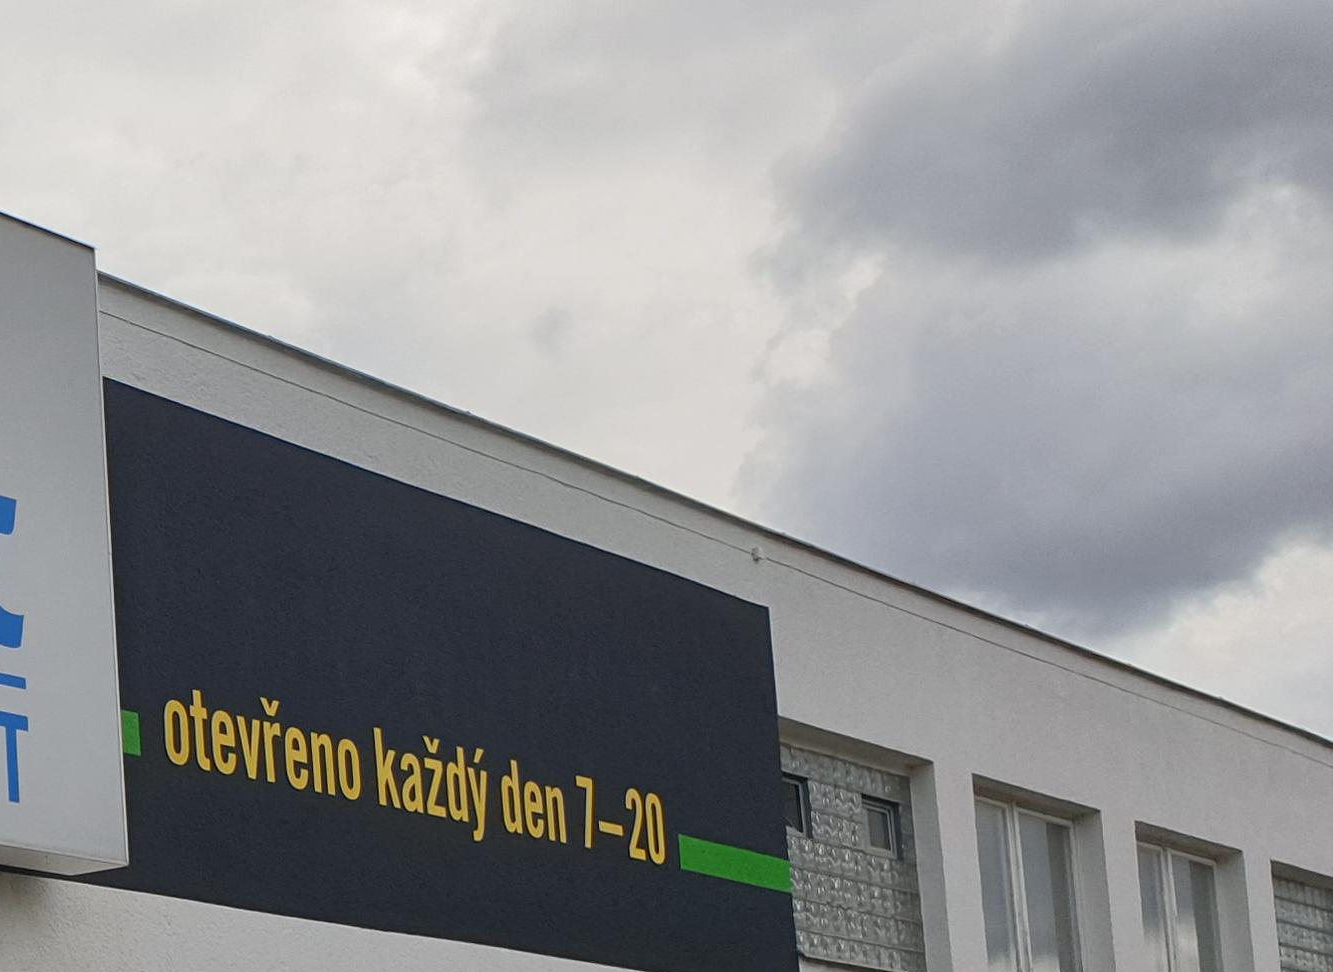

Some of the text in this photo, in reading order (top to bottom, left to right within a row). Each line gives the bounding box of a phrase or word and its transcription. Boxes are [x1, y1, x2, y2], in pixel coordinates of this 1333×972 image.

[163, 689, 362, 801] otevřeno
[373, 726, 488, 843] každý
[500, 759, 568, 845] den
